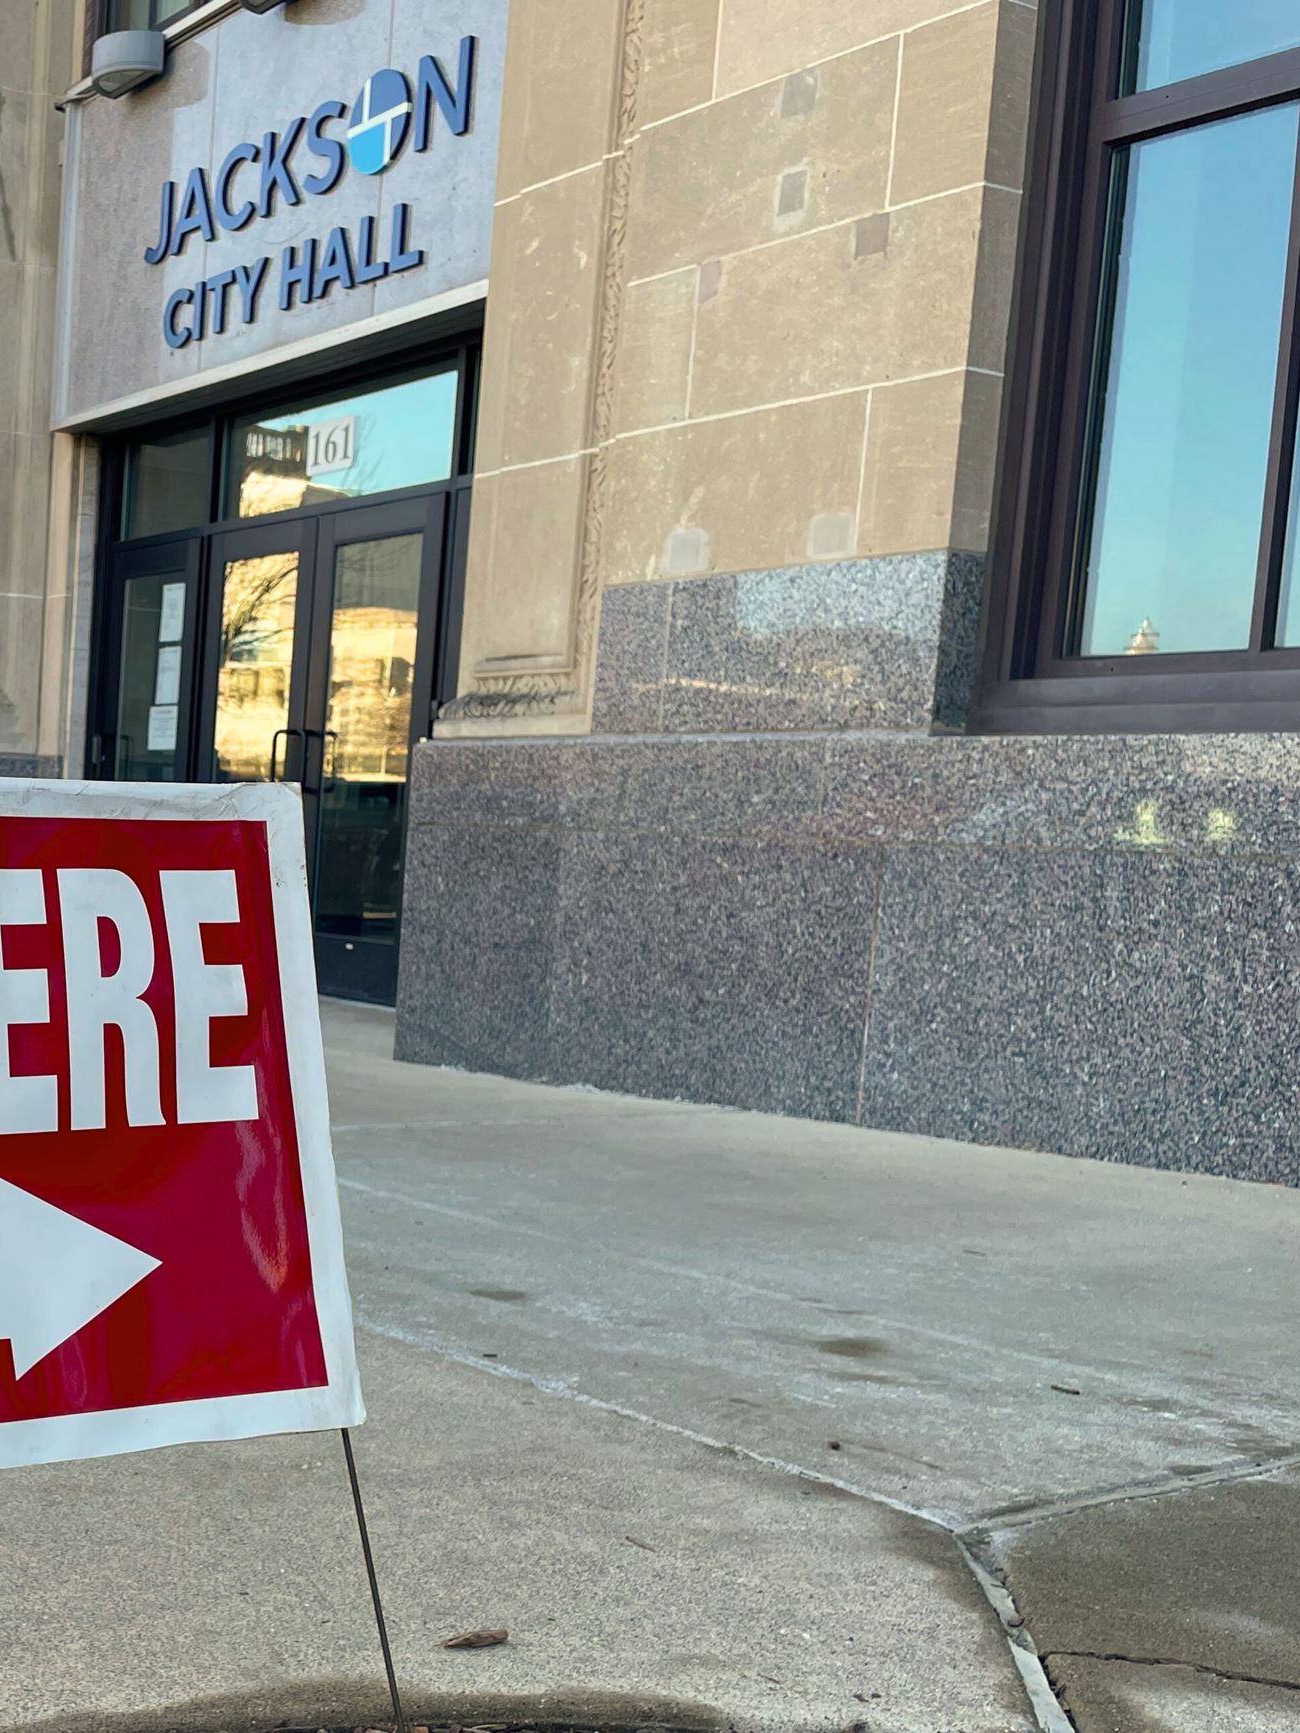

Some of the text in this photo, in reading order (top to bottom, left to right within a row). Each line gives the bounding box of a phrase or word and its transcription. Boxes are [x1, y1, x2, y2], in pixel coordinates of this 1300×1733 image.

[144, 35, 477, 265] JACKSON
[163, 203, 425, 349] CITY HALL
[311, 424, 351, 466] 161
